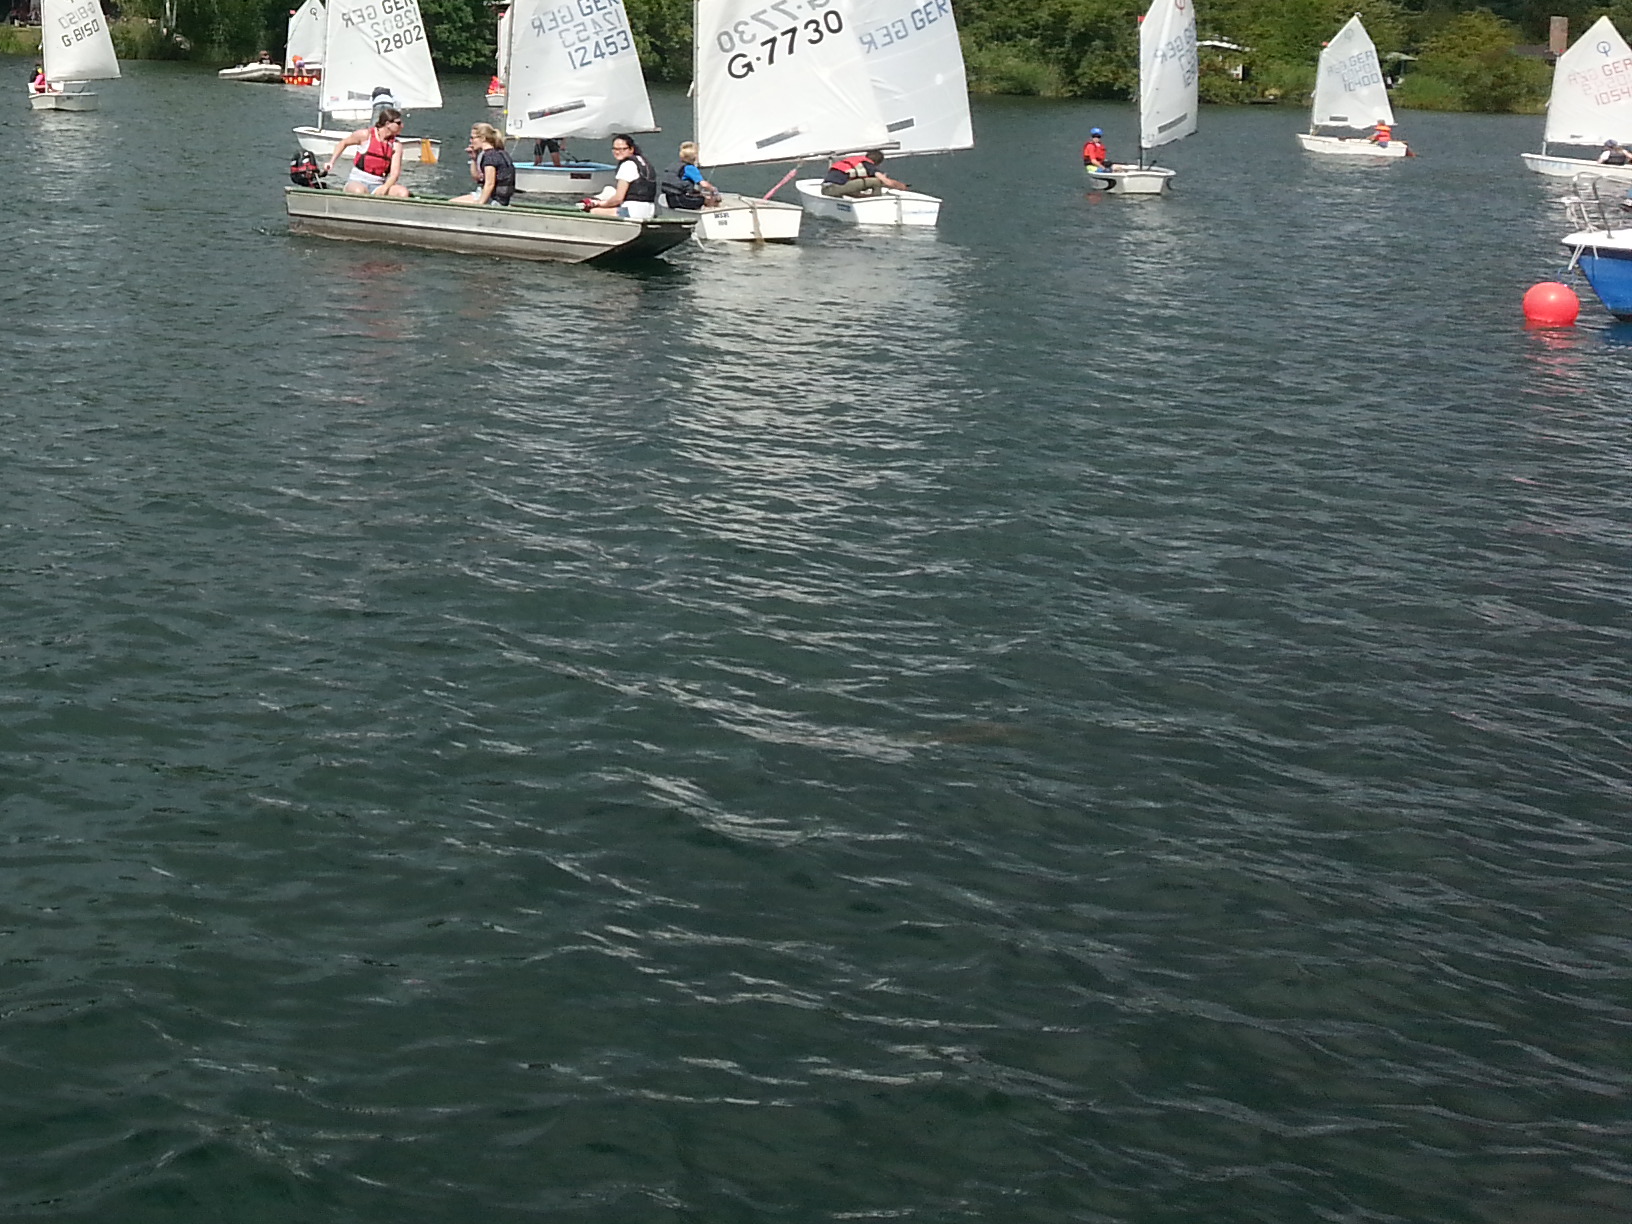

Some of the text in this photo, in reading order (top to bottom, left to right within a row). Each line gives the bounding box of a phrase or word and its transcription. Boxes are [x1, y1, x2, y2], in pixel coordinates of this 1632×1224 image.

[375, 25, 424, 55] 12802
[568, 30, 630, 70] 12453
[1349, 50, 1375, 67] GER
[1595, 86, 1632, 106] 1054
